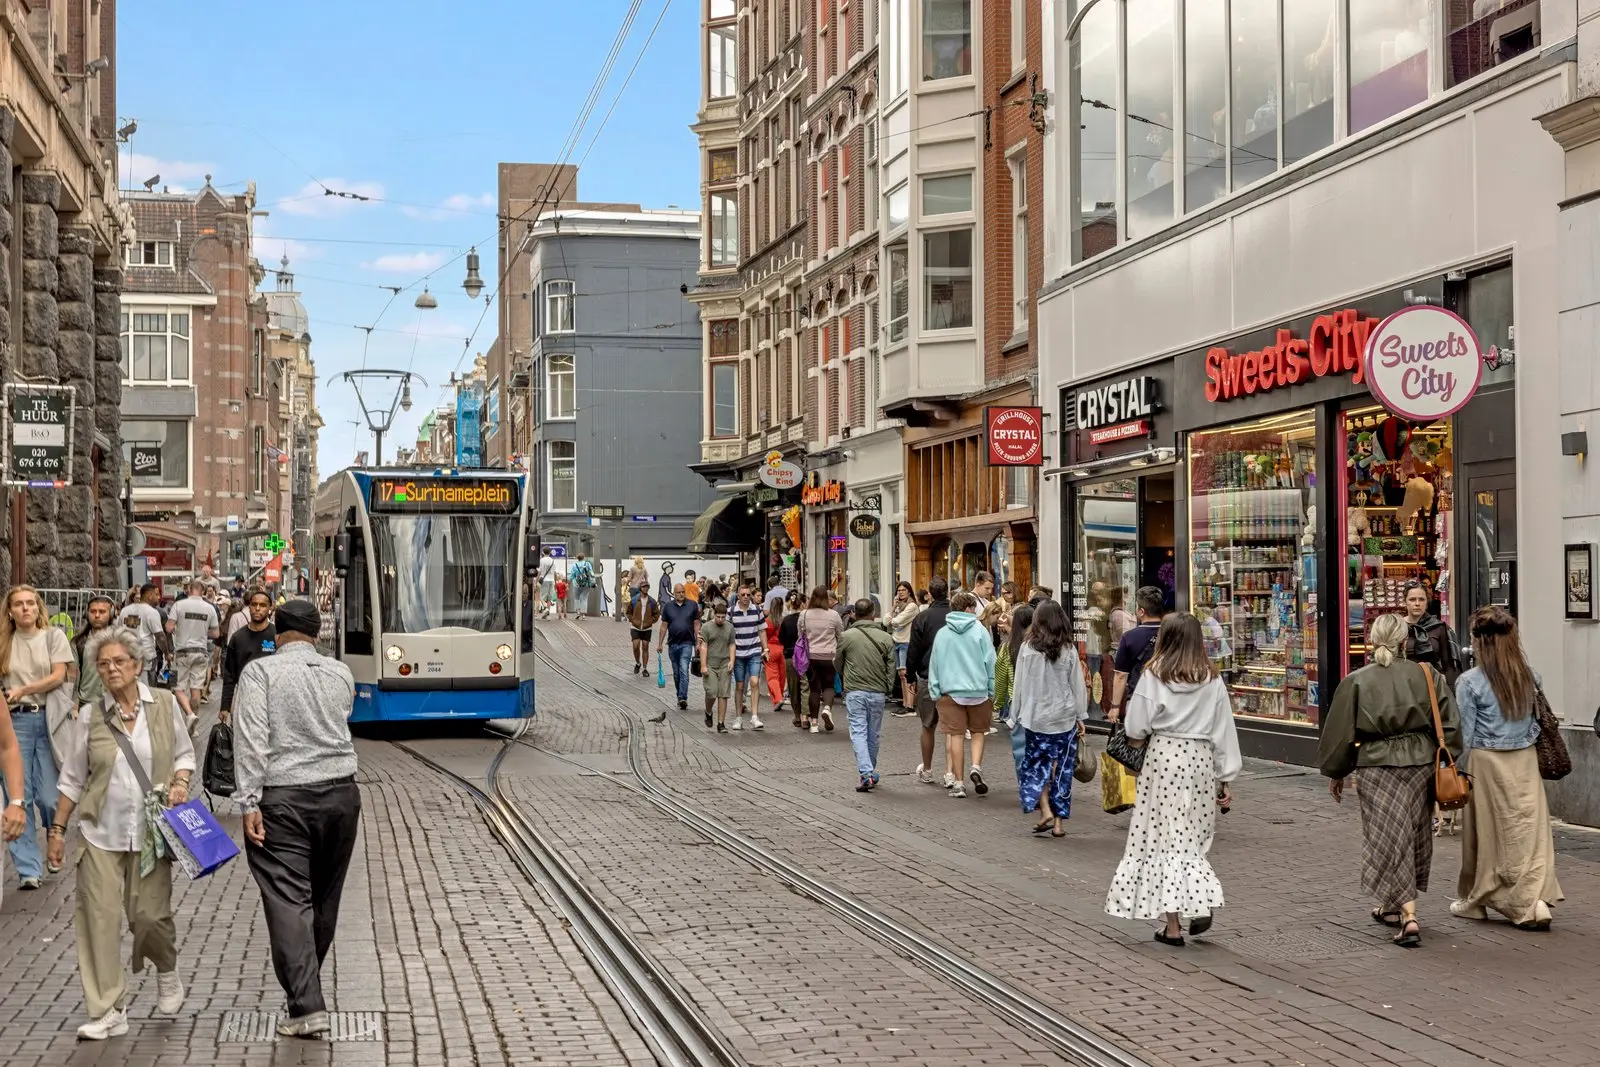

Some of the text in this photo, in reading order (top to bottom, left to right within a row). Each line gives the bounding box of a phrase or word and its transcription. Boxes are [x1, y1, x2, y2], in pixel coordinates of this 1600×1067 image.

[1205, 309, 1380, 402] Sweets City
[1379, 331, 1468, 368] Sweets
[1401, 365, 1457, 402] City
[32, 400, 48, 411] TE
[1077, 376, 1150, 430] CRYSTAL
[21, 410, 58, 421] HUUR
[997, 412, 1034, 426] GRILLHOUSE
[993, 429, 1037, 440] CRYSTAL
[32, 448, 46, 457] 020
[134, 452, 157, 465] Etos
[19, 458, 58, 468] 676 4 676
[767, 468, 793, 477] Chipsy
[776, 478, 794, 486] King
[381, 482, 509, 506] 17 Surinameplein
[825, 479, 840, 503] King
[1501, 572, 1509, 585] 93
